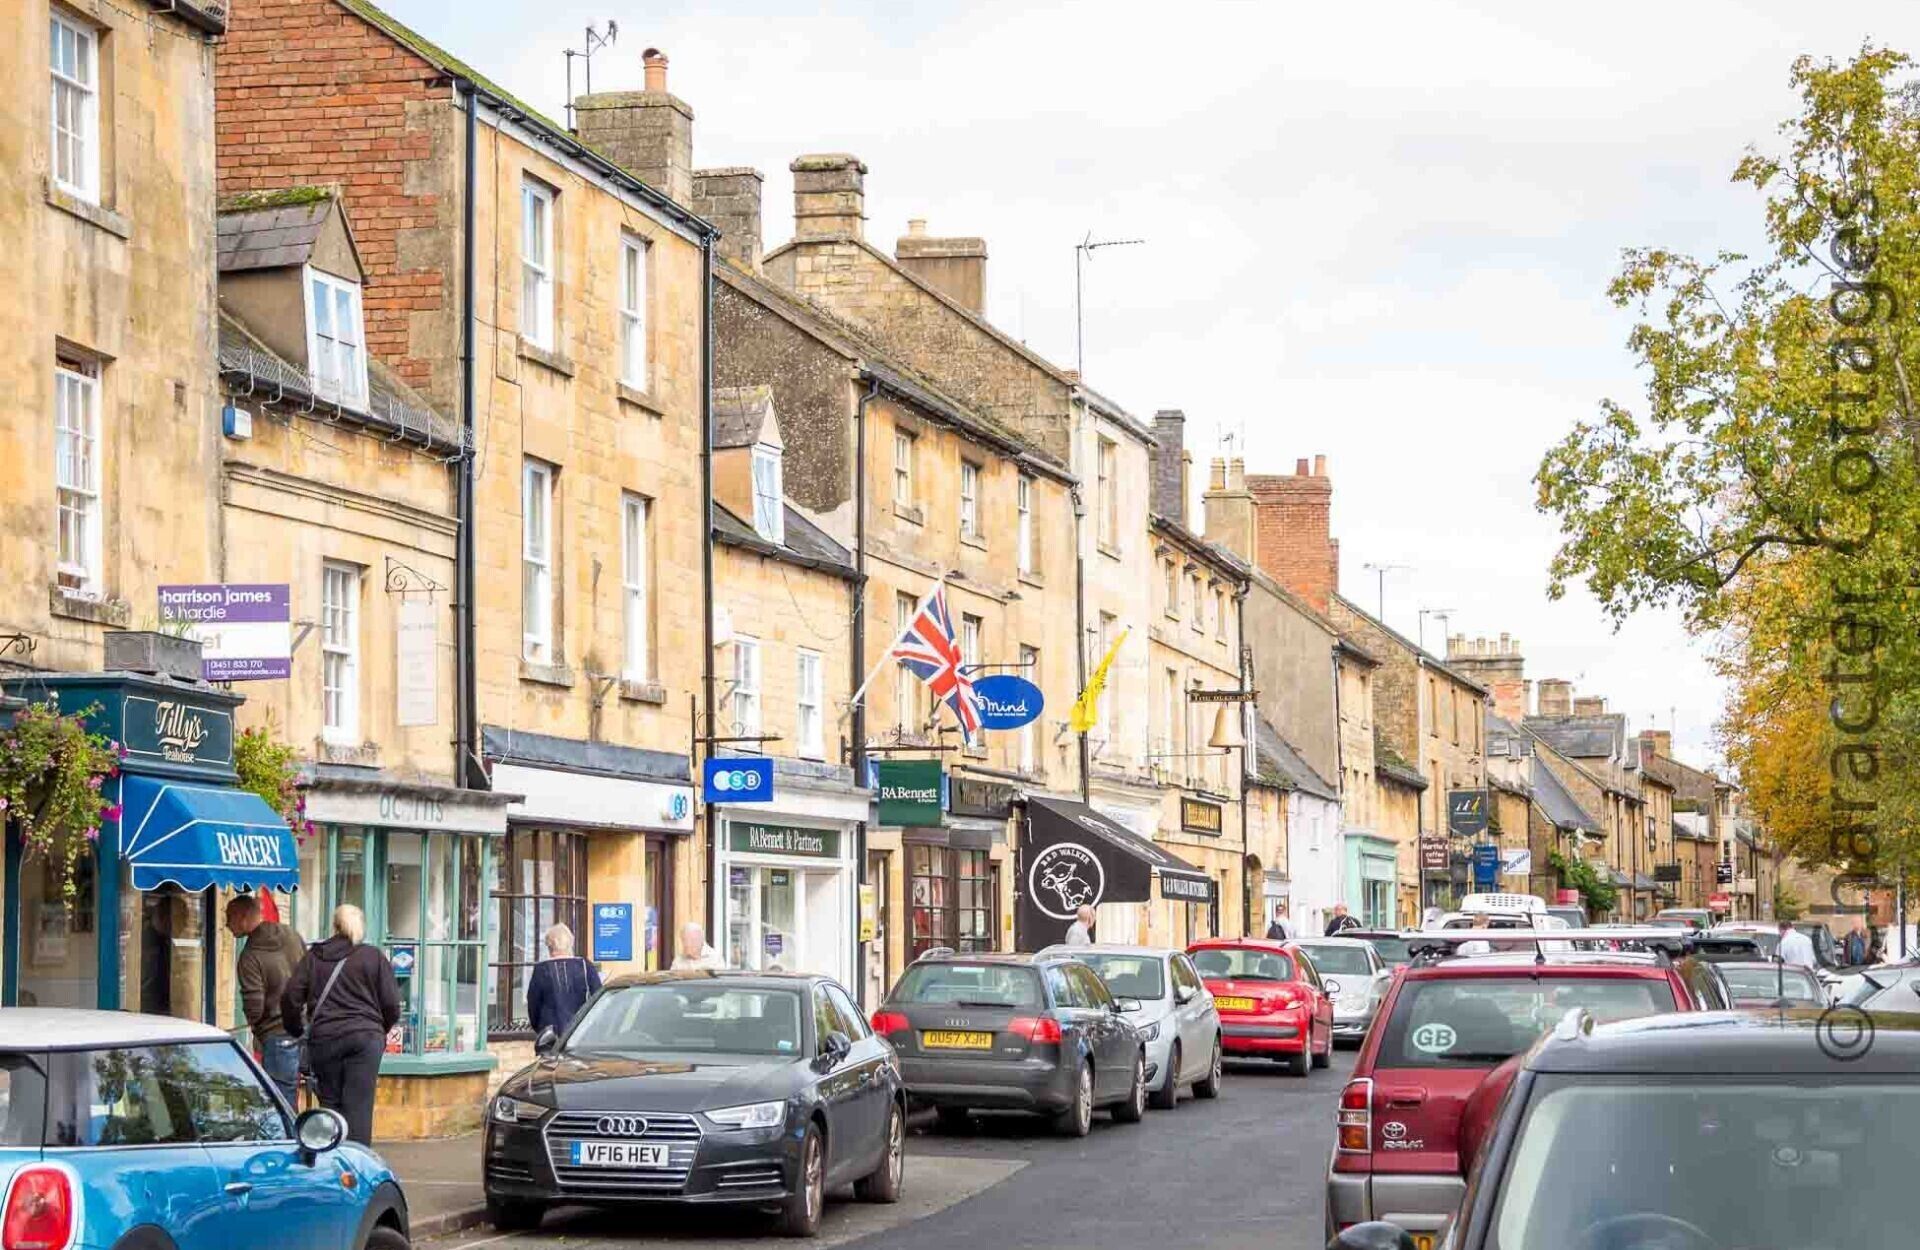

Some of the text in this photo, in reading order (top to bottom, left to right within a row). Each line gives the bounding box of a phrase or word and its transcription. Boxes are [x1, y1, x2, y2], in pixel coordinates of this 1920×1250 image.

[162, 588, 272, 606] harrison james
[164, 605, 227, 619] & hardie
[987, 699, 1029, 713] mind
[156, 701, 208, 751] Tilly's
[162, 746, 195, 764] Teahouse
[379, 793, 444, 823] acrns
[216, 832, 283, 866] BAKERY
[794, 830, 823, 852] Partners
[1059, 849, 1091, 866] WALKER
[1416, 1029, 1451, 1046] GB
[587, 1145, 661, 1163] VF16 HEV
